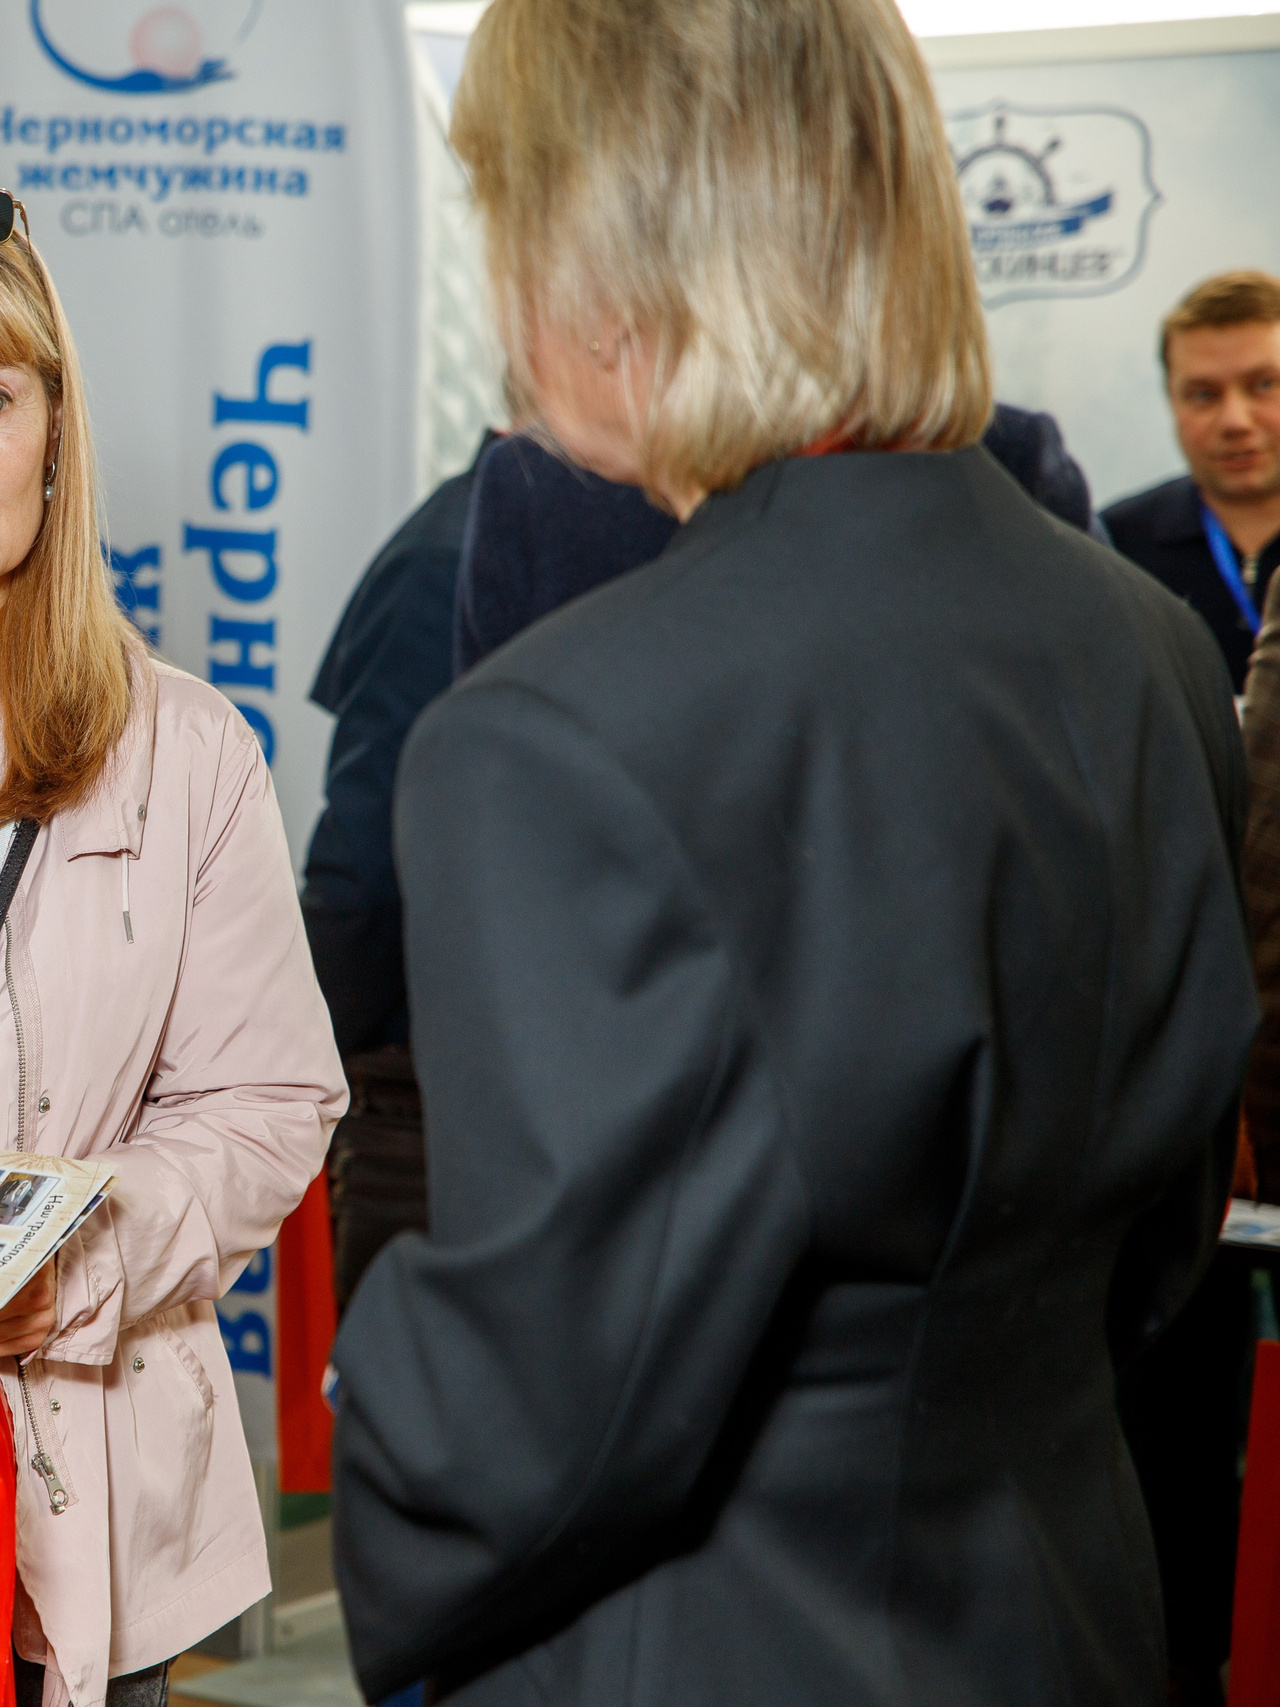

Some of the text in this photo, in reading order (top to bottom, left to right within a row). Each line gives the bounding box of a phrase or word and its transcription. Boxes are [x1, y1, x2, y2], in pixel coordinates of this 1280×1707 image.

[18, 163, 310, 201] жемчужина
[60, 201, 265, 239] СПА отель
[40, 1194, 64, 1219] Наш
